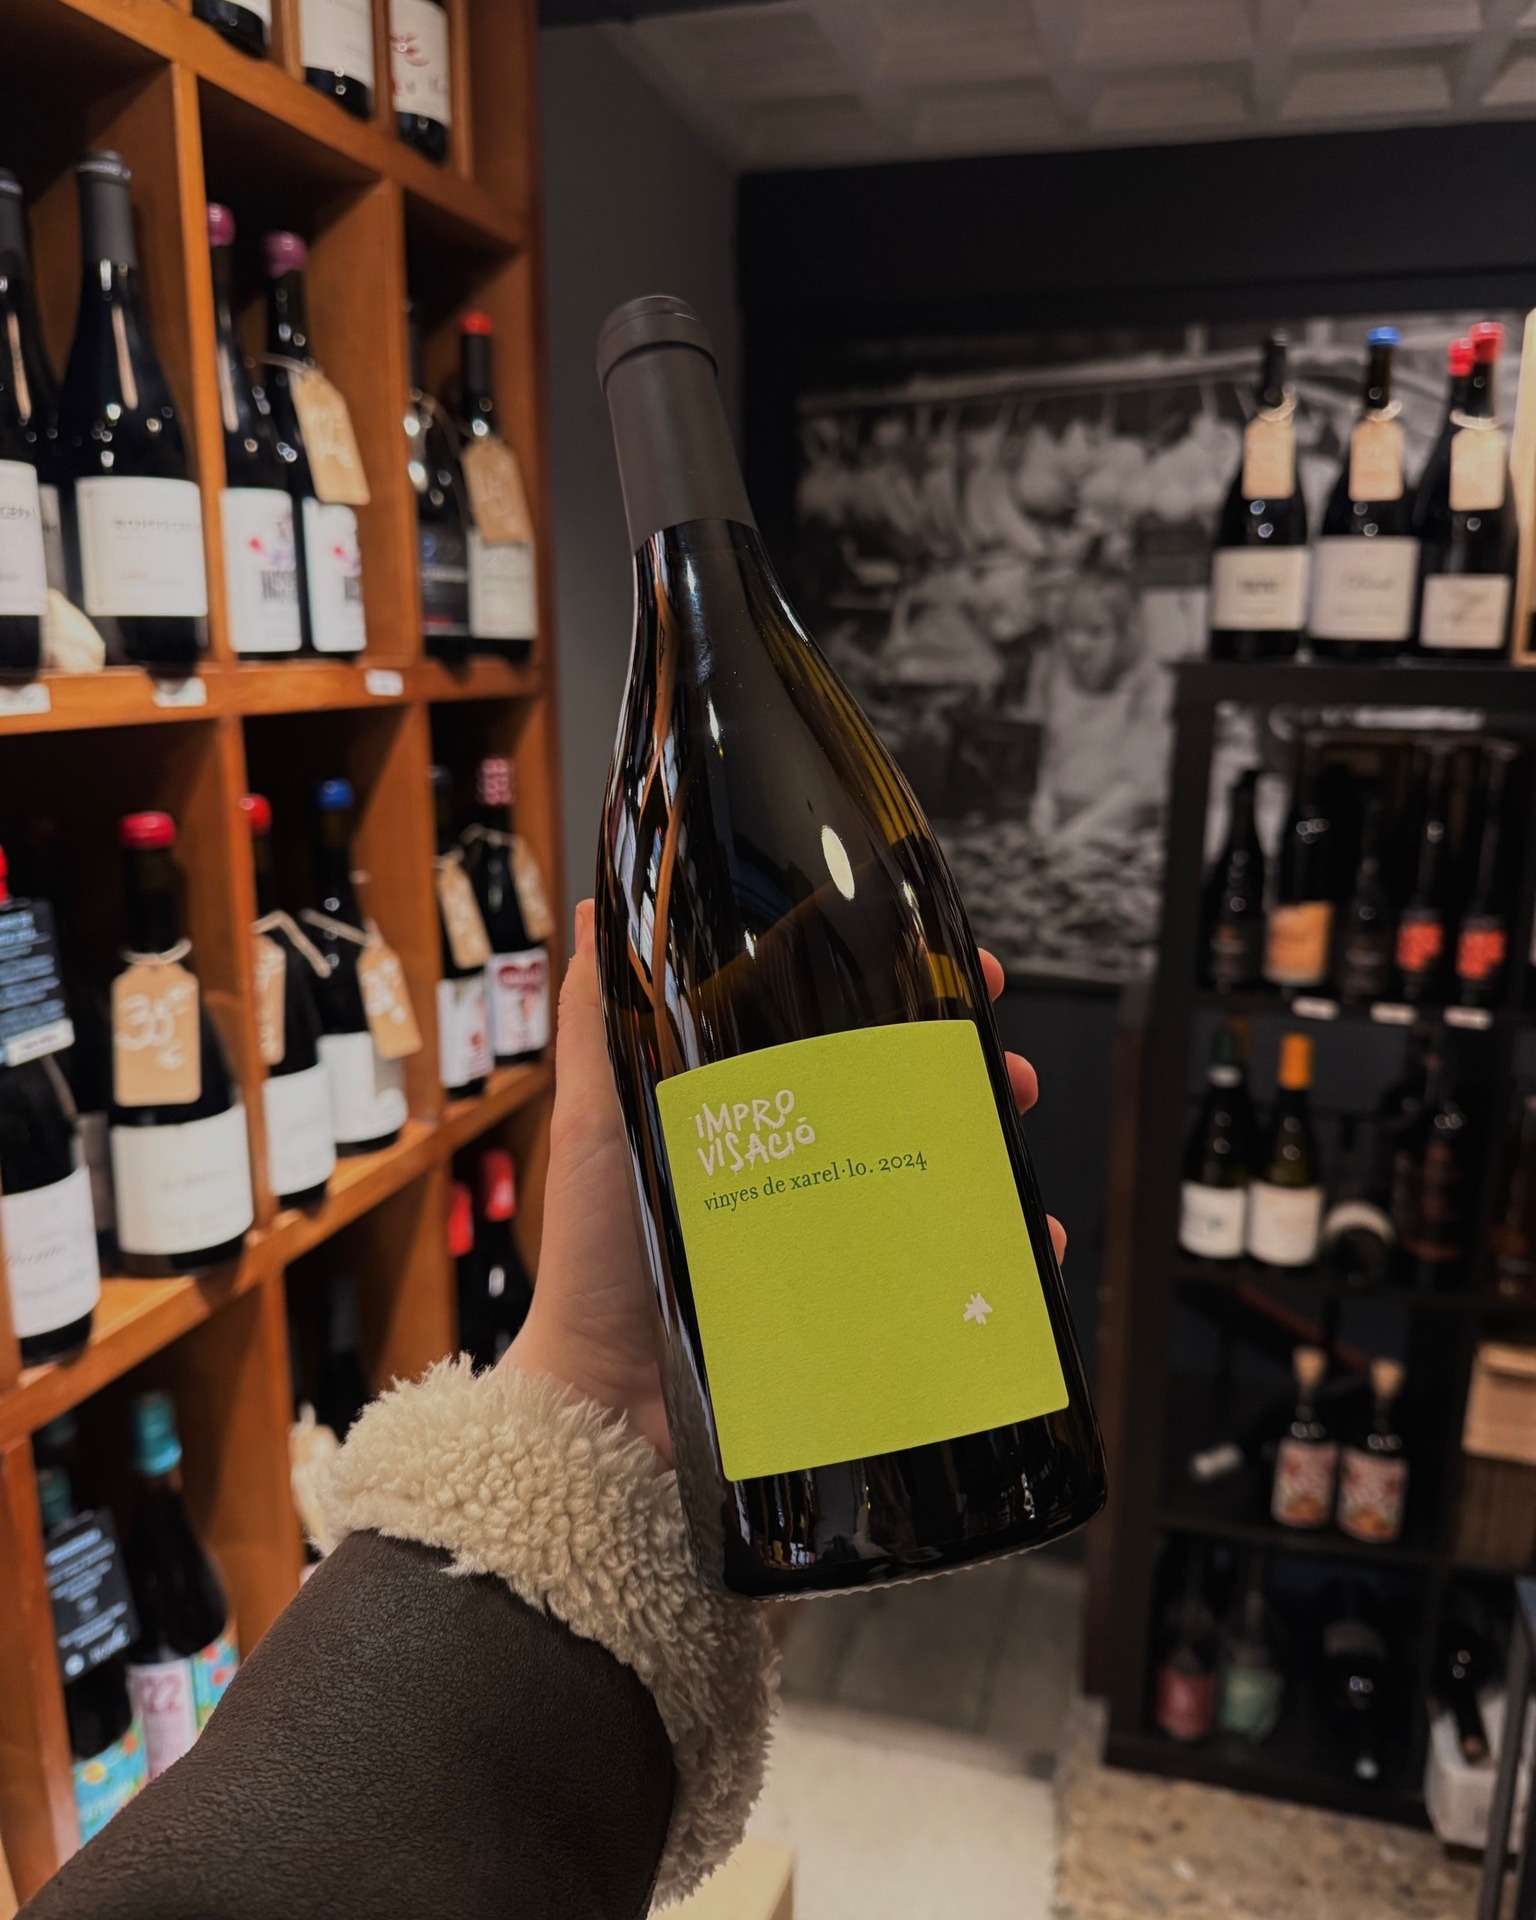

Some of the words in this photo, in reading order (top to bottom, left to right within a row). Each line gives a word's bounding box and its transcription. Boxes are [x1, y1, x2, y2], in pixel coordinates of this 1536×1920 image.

[696, 1090, 795, 1142] IMPRO
[697, 1116, 815, 1176] VISACIÓ
[704, 1187, 759, 1211] vinyes
[763, 1176, 786, 1197] de
[879, 1151, 927, 1171] 2024
